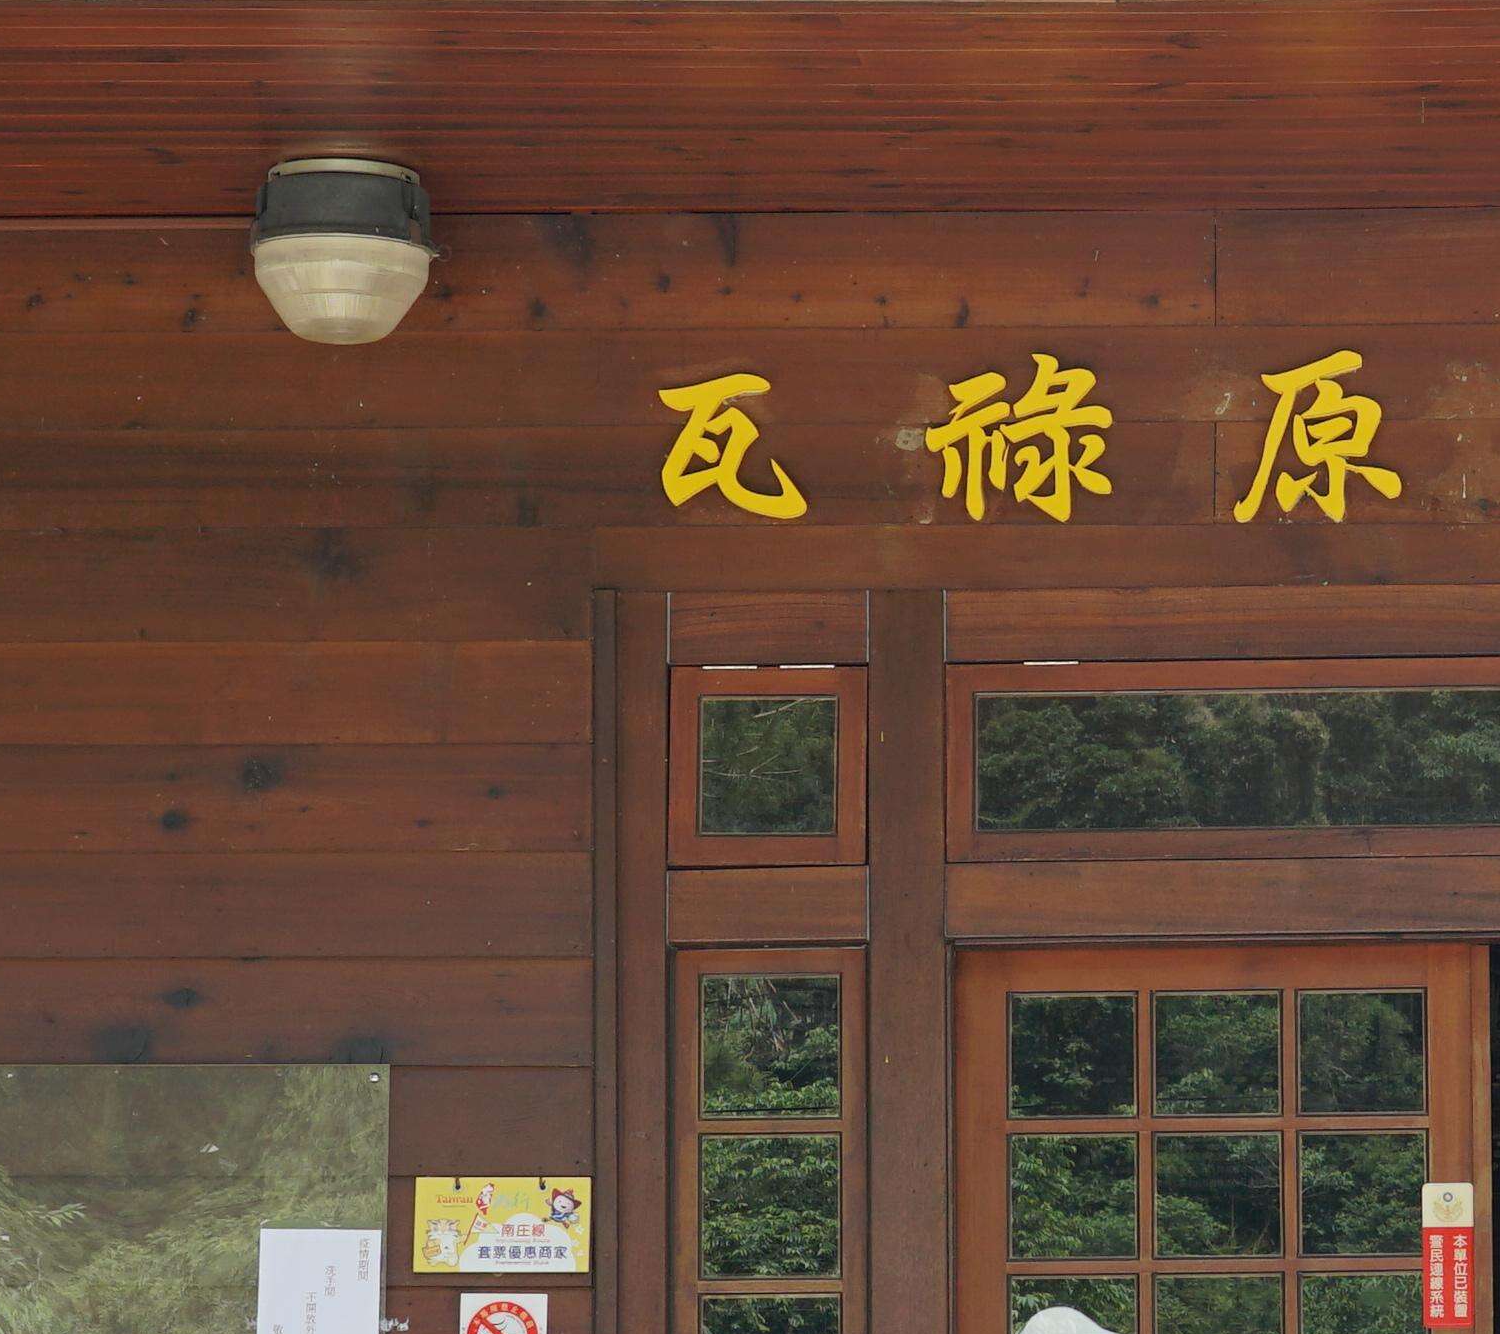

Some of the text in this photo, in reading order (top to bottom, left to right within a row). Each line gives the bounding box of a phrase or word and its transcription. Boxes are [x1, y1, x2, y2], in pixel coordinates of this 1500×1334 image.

[1429, 1234, 1445, 1319] 警民連線系統
